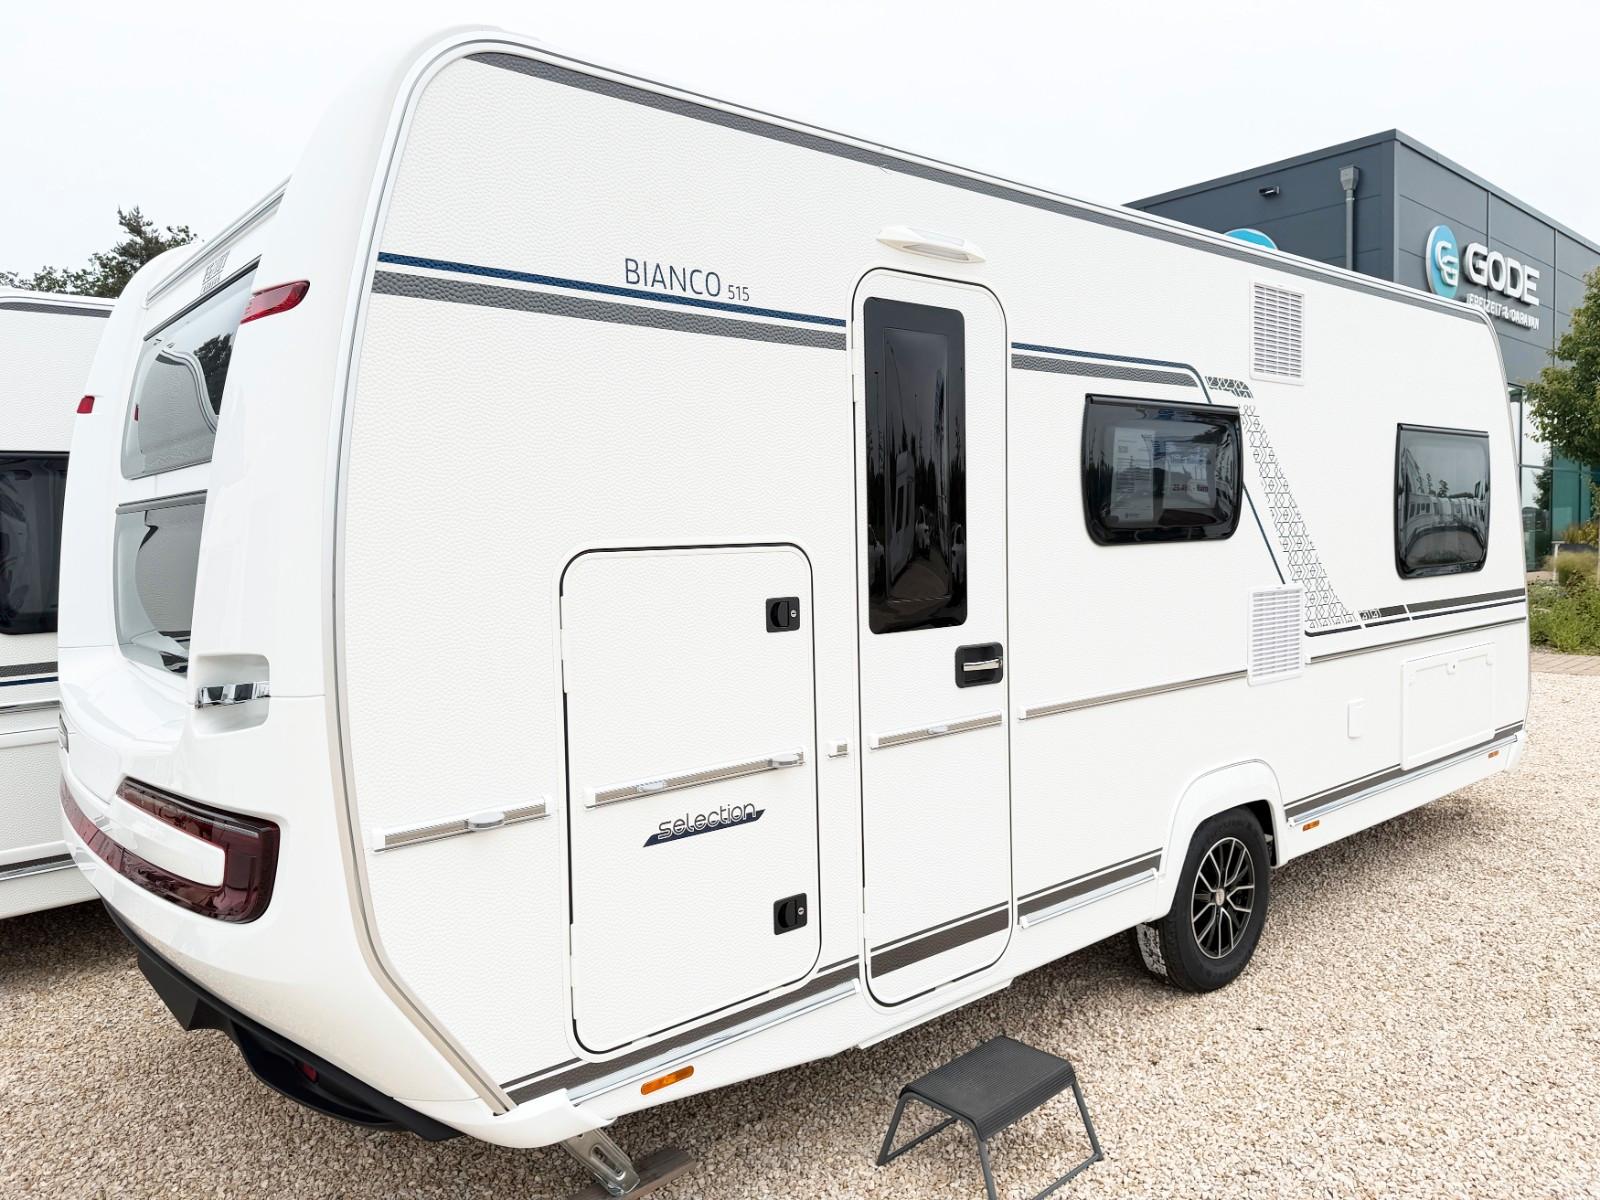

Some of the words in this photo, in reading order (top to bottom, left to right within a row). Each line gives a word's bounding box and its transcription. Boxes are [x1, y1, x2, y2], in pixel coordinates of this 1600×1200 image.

[625, 257, 722, 298] BIANCO
[728, 285, 750, 302] 515
[1464, 242, 1540, 306] GODE
[658, 802, 757, 840] selection
